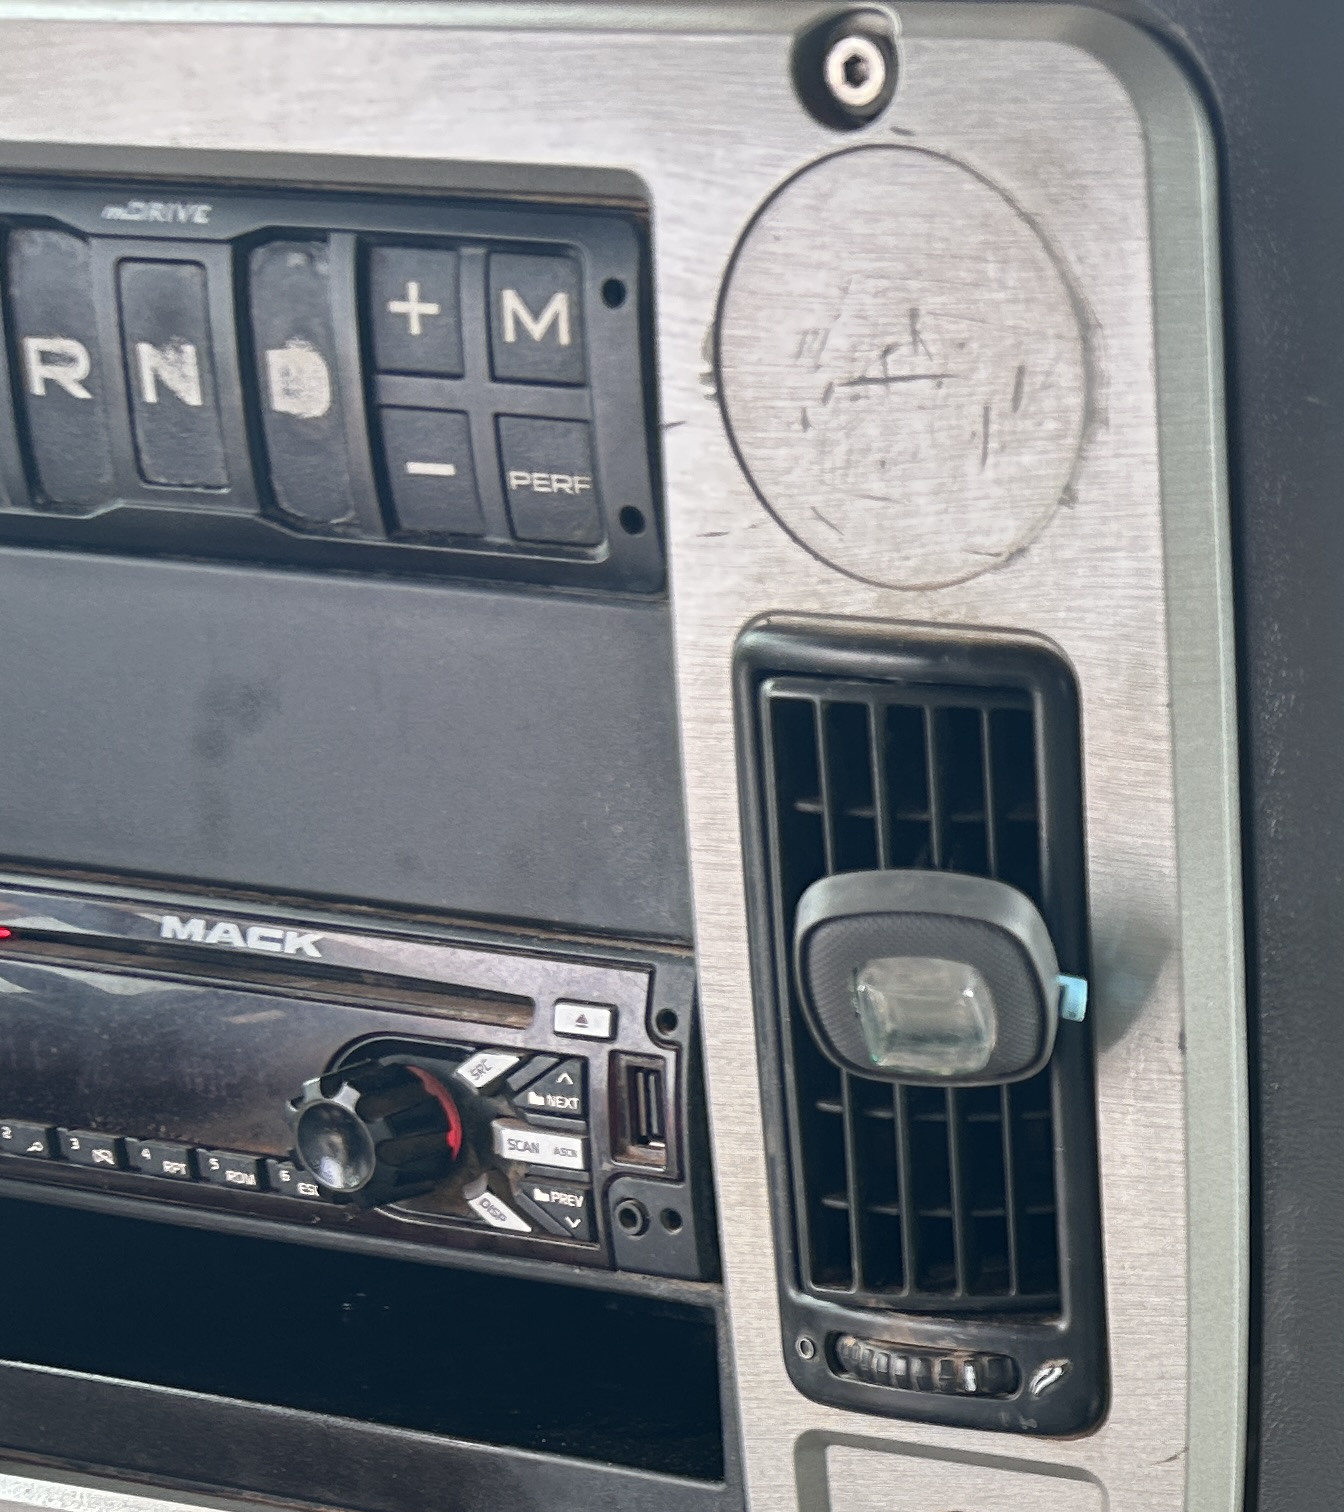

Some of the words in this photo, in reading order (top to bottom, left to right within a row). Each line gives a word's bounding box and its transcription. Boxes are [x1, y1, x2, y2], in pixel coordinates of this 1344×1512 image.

[502, 288, 570, 346] M
[22, 336, 92, 399] R
[134, 340, 202, 406] N
[508, 470, 592, 495] PERF
[160, 914, 324, 958] MACK
[470, 1058, 493, 1081] SRC
[545, 1094, 580, 1110] NEXT
[69, 1137, 81, 1150] 3
[507, 1138, 540, 1155] SCAN
[207, 1157, 221, 1171] 5
[478, 1197, 508, 1223] DISP
[550, 1190, 584, 1208] PREV
